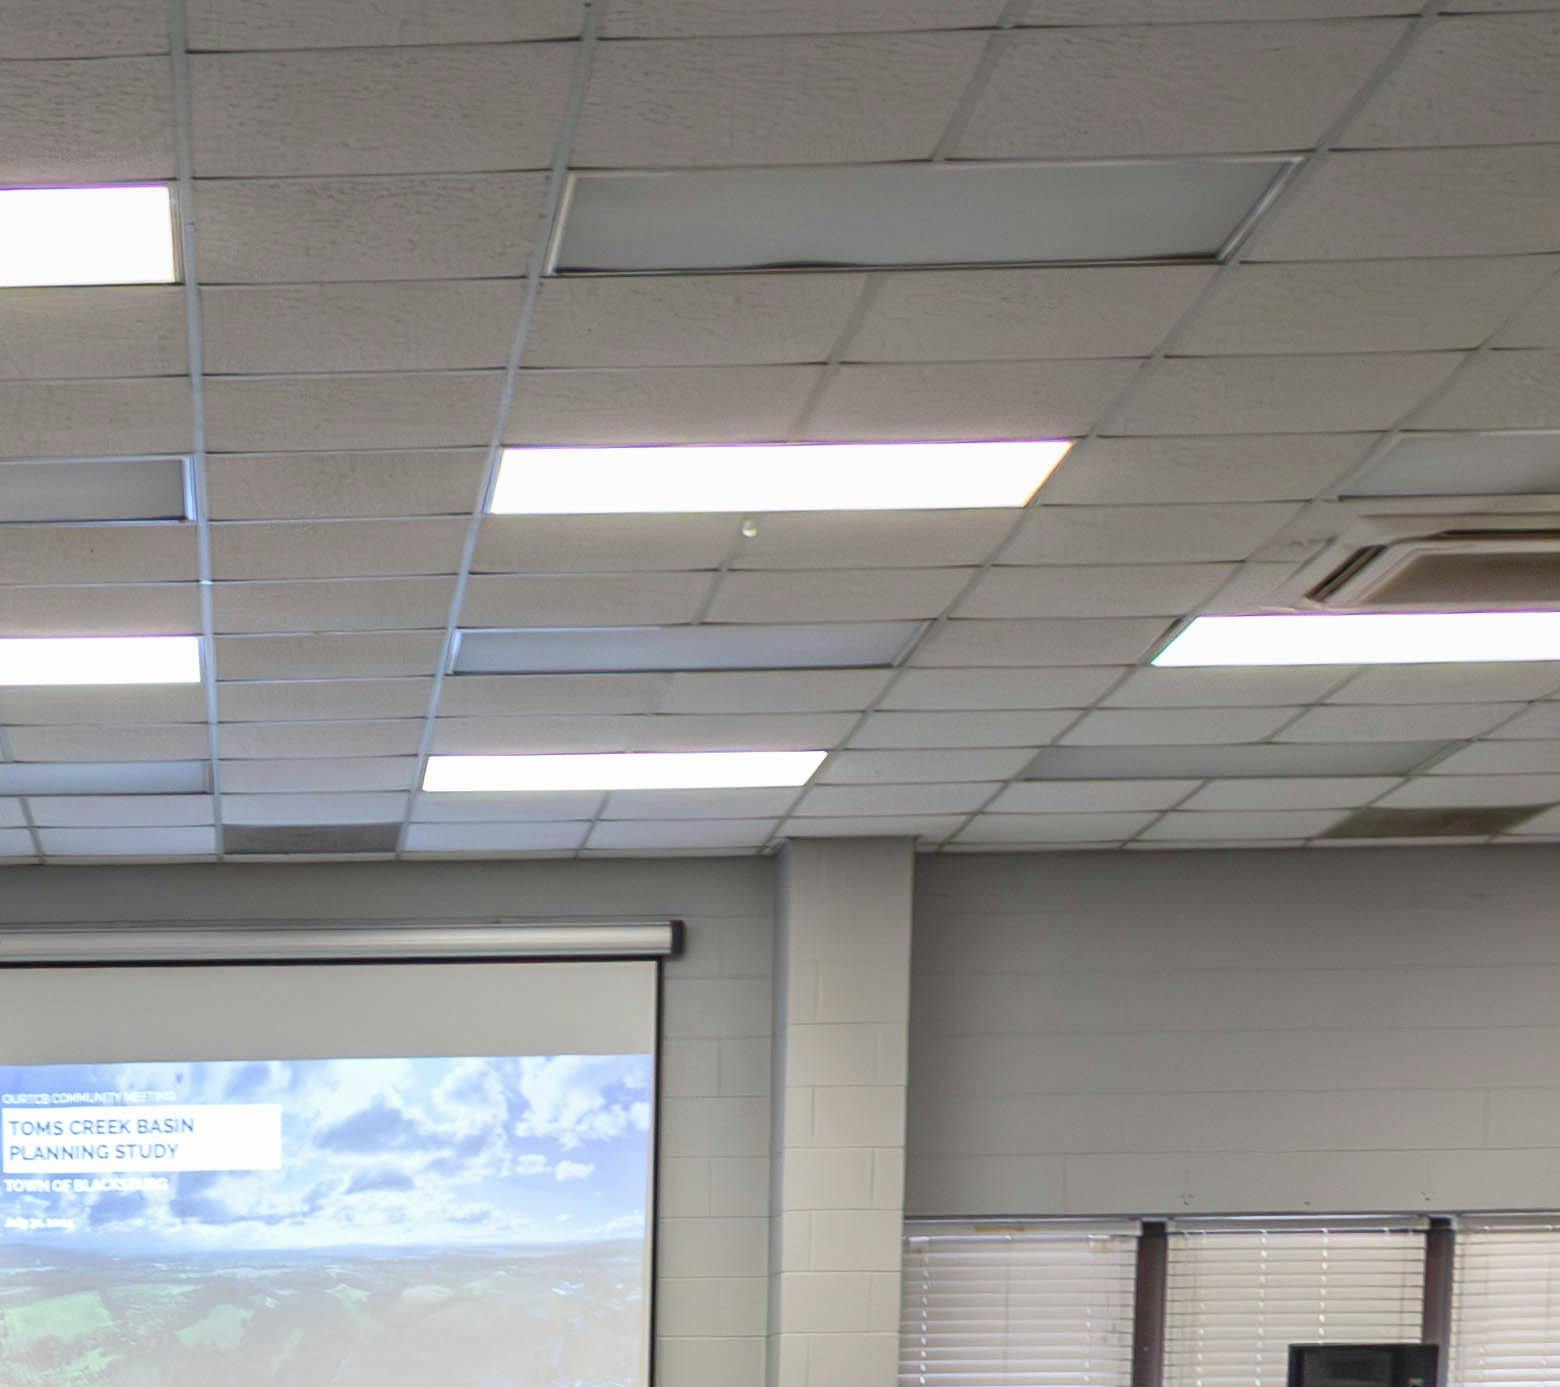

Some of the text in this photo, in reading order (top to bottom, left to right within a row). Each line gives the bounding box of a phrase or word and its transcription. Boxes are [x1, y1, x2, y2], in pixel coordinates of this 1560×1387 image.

[9, 1118, 195, 1136] TOMS CREEK BASIN
[9, 1143, 179, 1161] PLANNING STUDY
[3, 1179, 50, 1193] TOWN
[52, 1179, 72, 1193] OF
